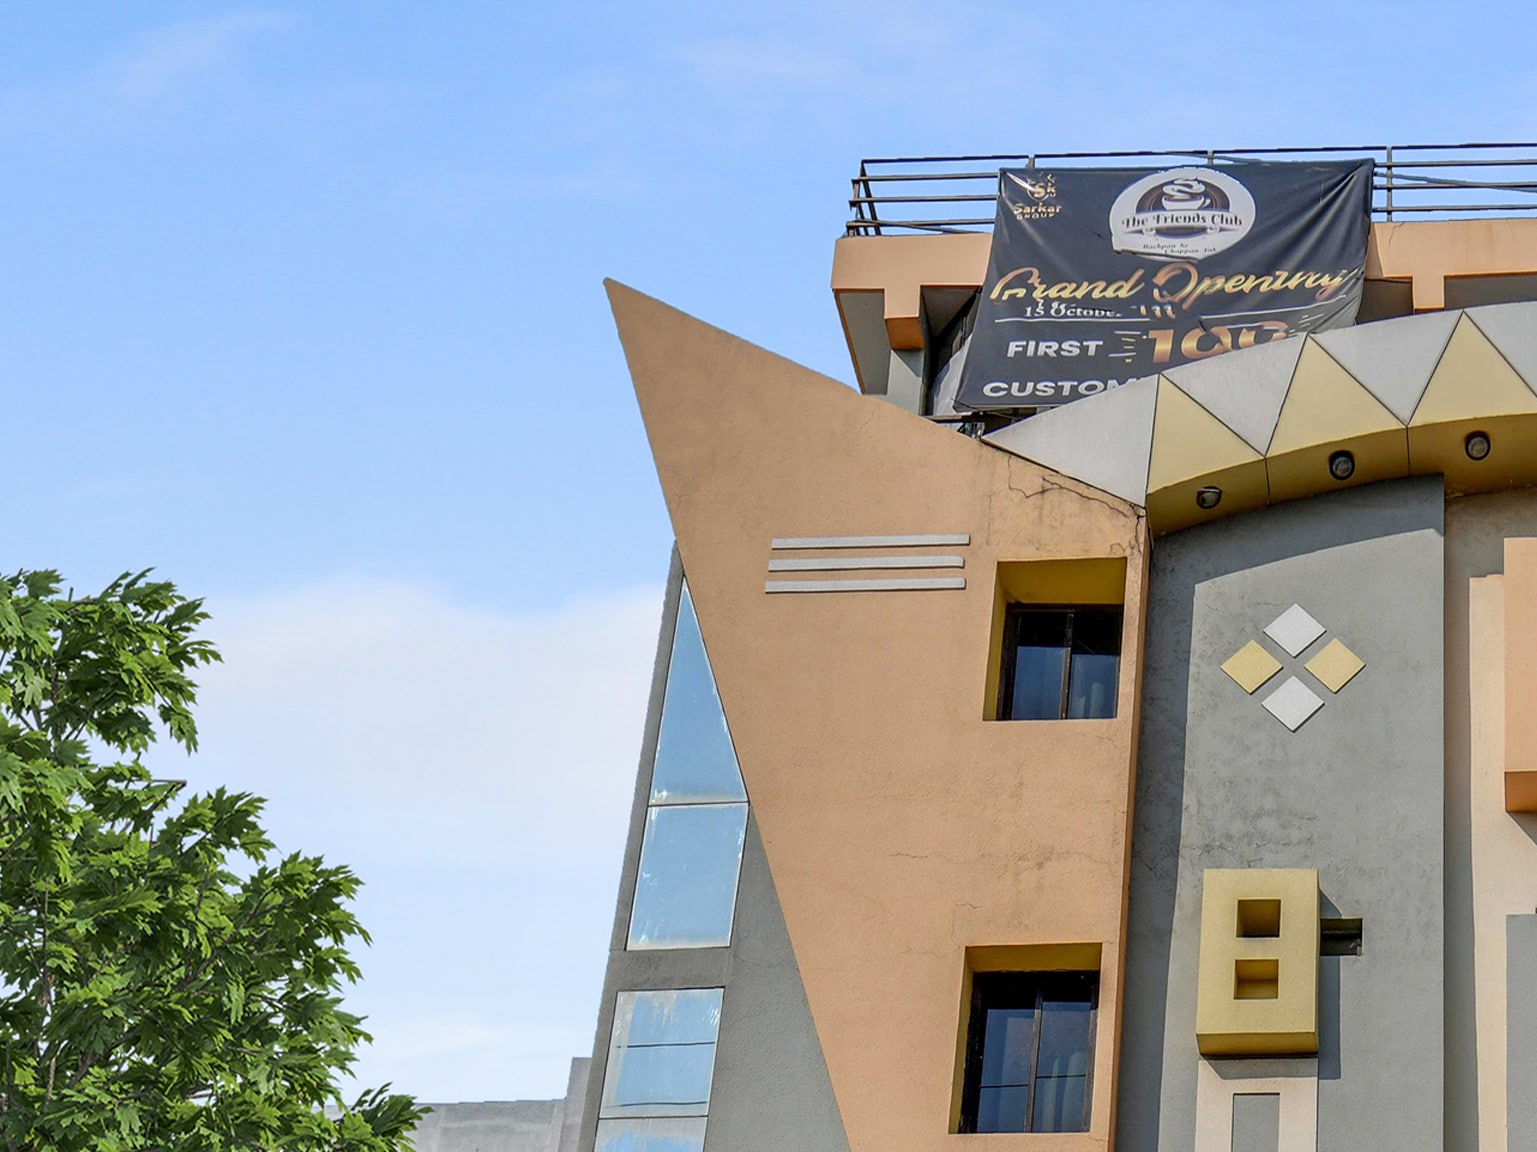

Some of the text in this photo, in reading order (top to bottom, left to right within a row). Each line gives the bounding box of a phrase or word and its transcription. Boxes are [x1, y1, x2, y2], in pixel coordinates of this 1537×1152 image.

[1013, 202, 1062, 214] Sarkar
[1121, 212, 1242, 228] The Friends Club
[990, 266, 1145, 303] Grand
[1007, 340, 1104, 358] FIRST
